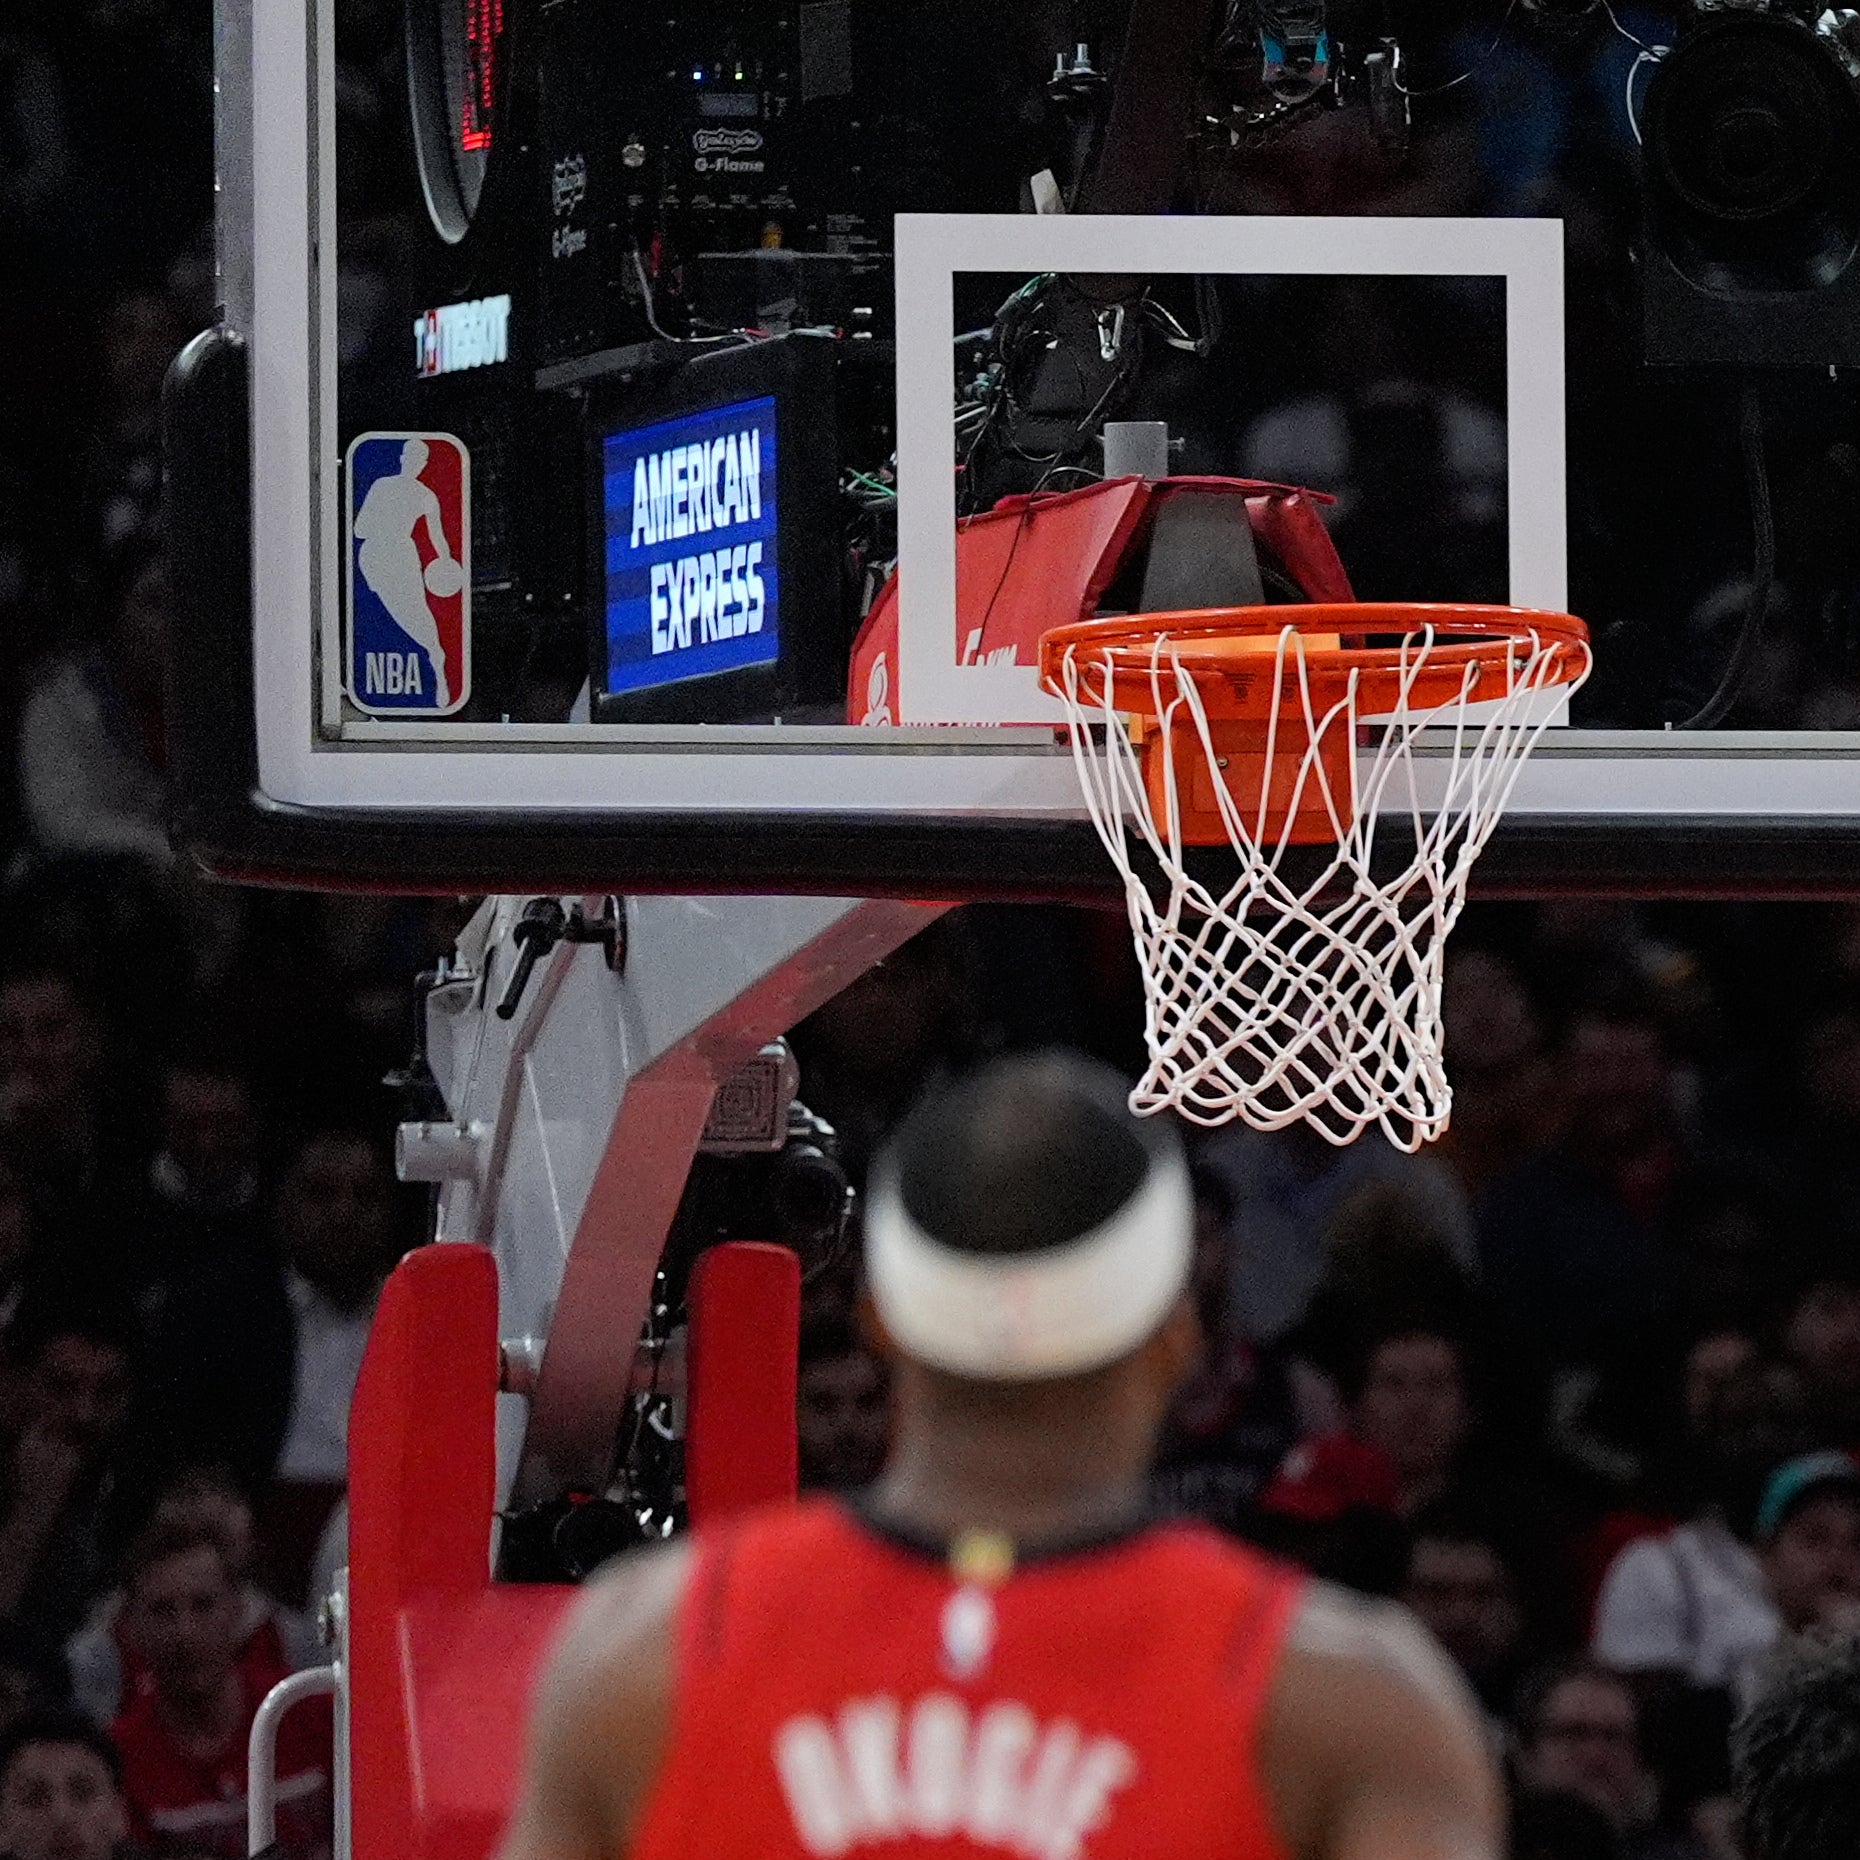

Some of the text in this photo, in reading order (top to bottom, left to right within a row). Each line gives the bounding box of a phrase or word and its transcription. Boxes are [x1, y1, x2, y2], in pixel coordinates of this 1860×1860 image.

[631, 428, 761, 549] AMERICAN
[650, 541, 765, 655] EXPRESS
[365, 652, 423, 695] NBA
